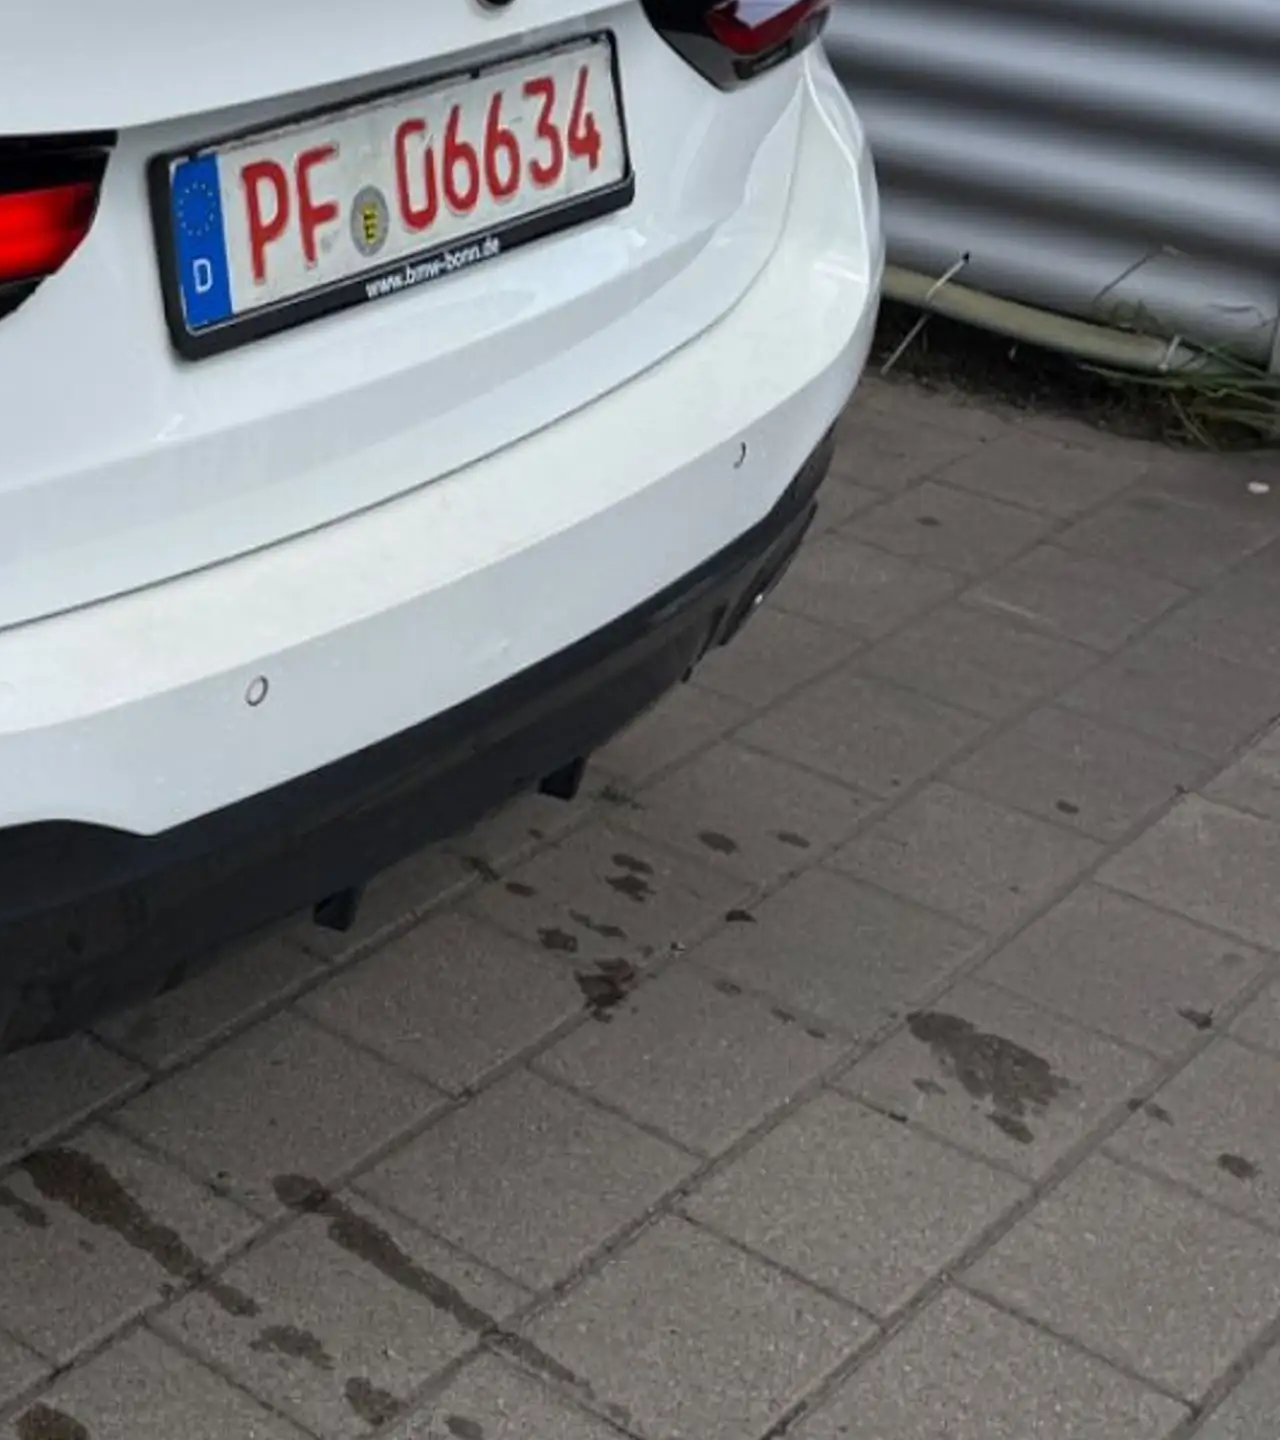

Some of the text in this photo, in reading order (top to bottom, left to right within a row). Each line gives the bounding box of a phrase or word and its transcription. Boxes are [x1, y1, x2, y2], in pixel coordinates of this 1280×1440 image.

[242, 65, 602, 284] PF 06634
[194, 259, 214, 294] D
[365, 237, 501, 298] www.bmw-bonn.de
